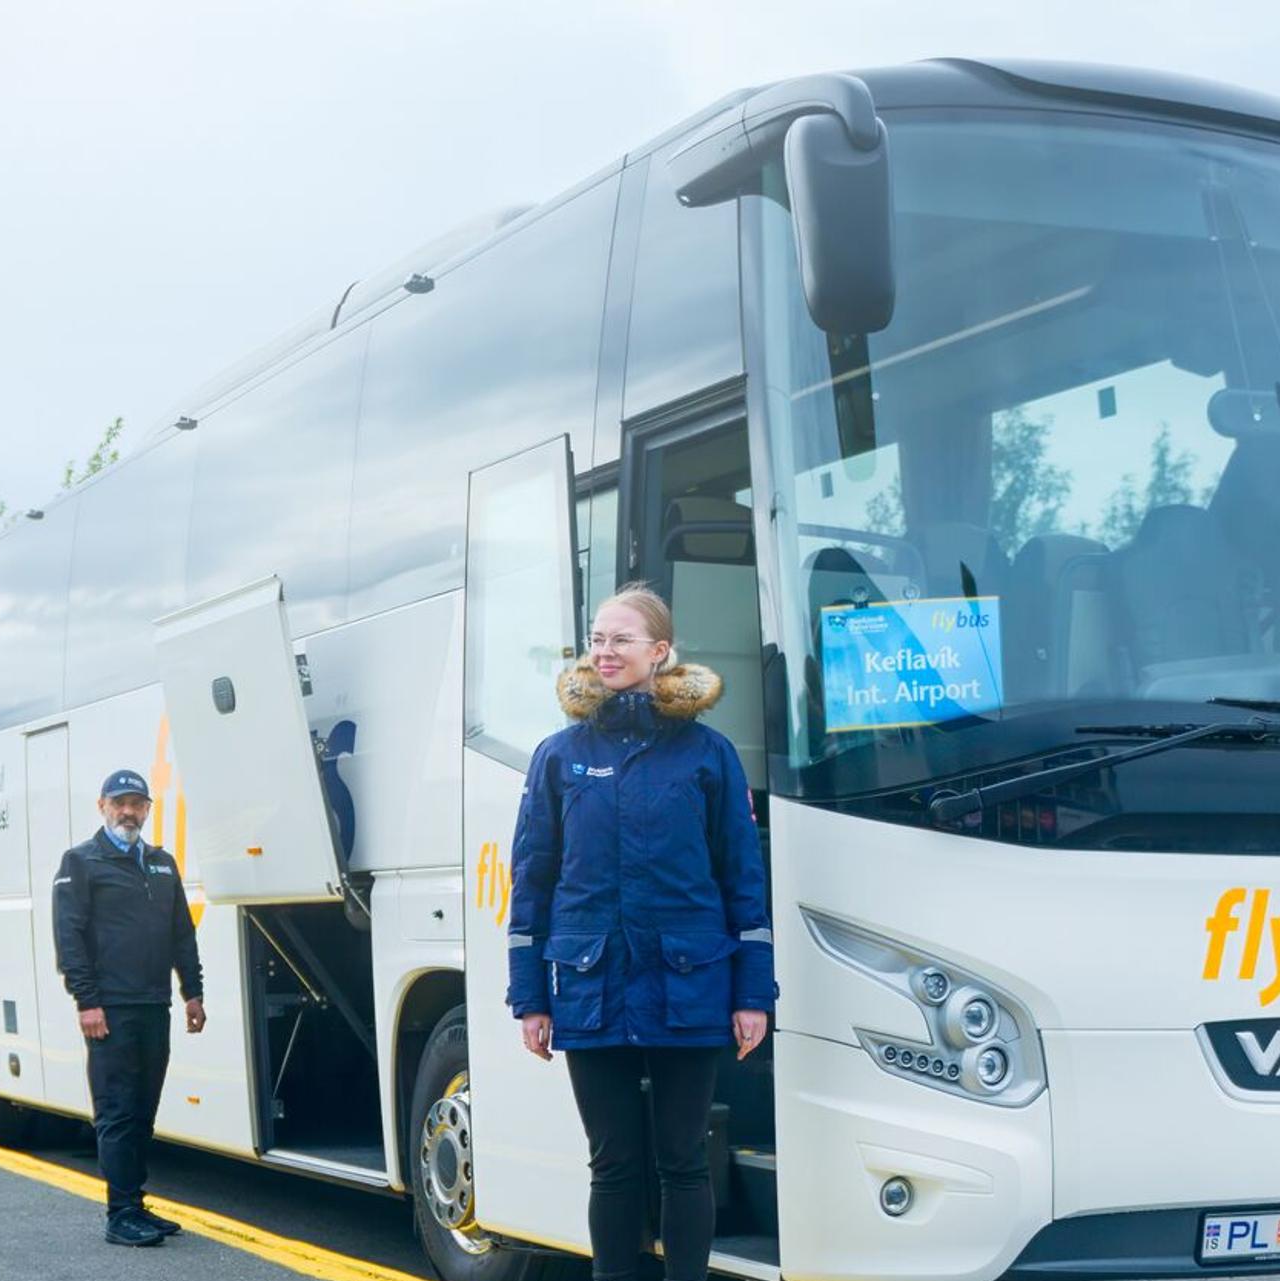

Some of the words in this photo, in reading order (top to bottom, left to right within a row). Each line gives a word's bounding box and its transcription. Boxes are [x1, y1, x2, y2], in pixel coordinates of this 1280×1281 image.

[930, 609, 990, 633] flybus
[847, 684, 887, 705] Int.
[894, 679, 981, 708] Airport
[1205, 1237, 1219, 1250] IS
[1227, 1220, 1269, 1250] PL
